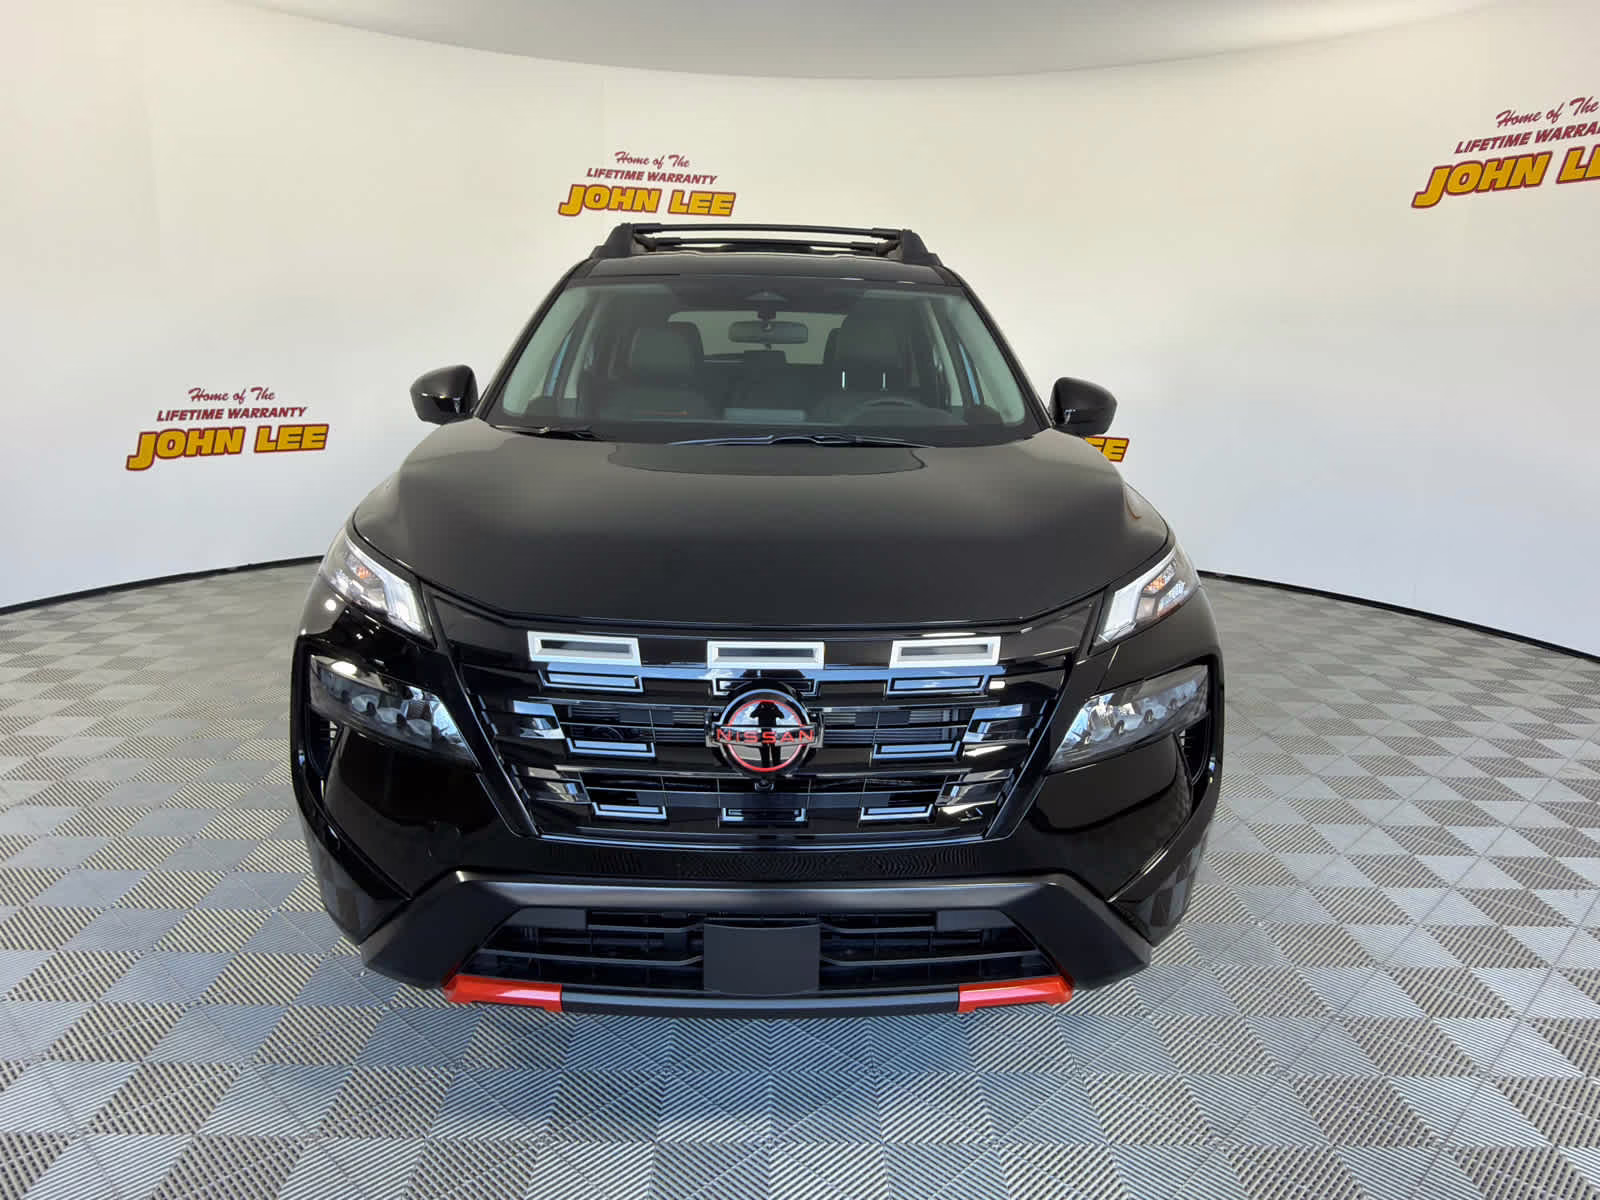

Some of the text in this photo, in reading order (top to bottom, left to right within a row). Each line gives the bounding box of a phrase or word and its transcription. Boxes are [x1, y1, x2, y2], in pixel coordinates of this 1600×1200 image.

[1495, 95, 1600, 128] Home of The
[1454, 121, 1600, 154] LIFETIME WARRA
[614, 151, 690, 169] Home of The
[586, 168, 718, 185] LIFETIME WARRANTY
[1411, 151, 1553, 208] JOHN
[558, 184, 737, 217] JOHN LEE
[188, 387, 276, 405] Home of The
[156, 406, 307, 422] LIFETIME WARRANTY
[126, 424, 329, 471] JOHN LEE
[716, 728, 815, 745] NISSAN
